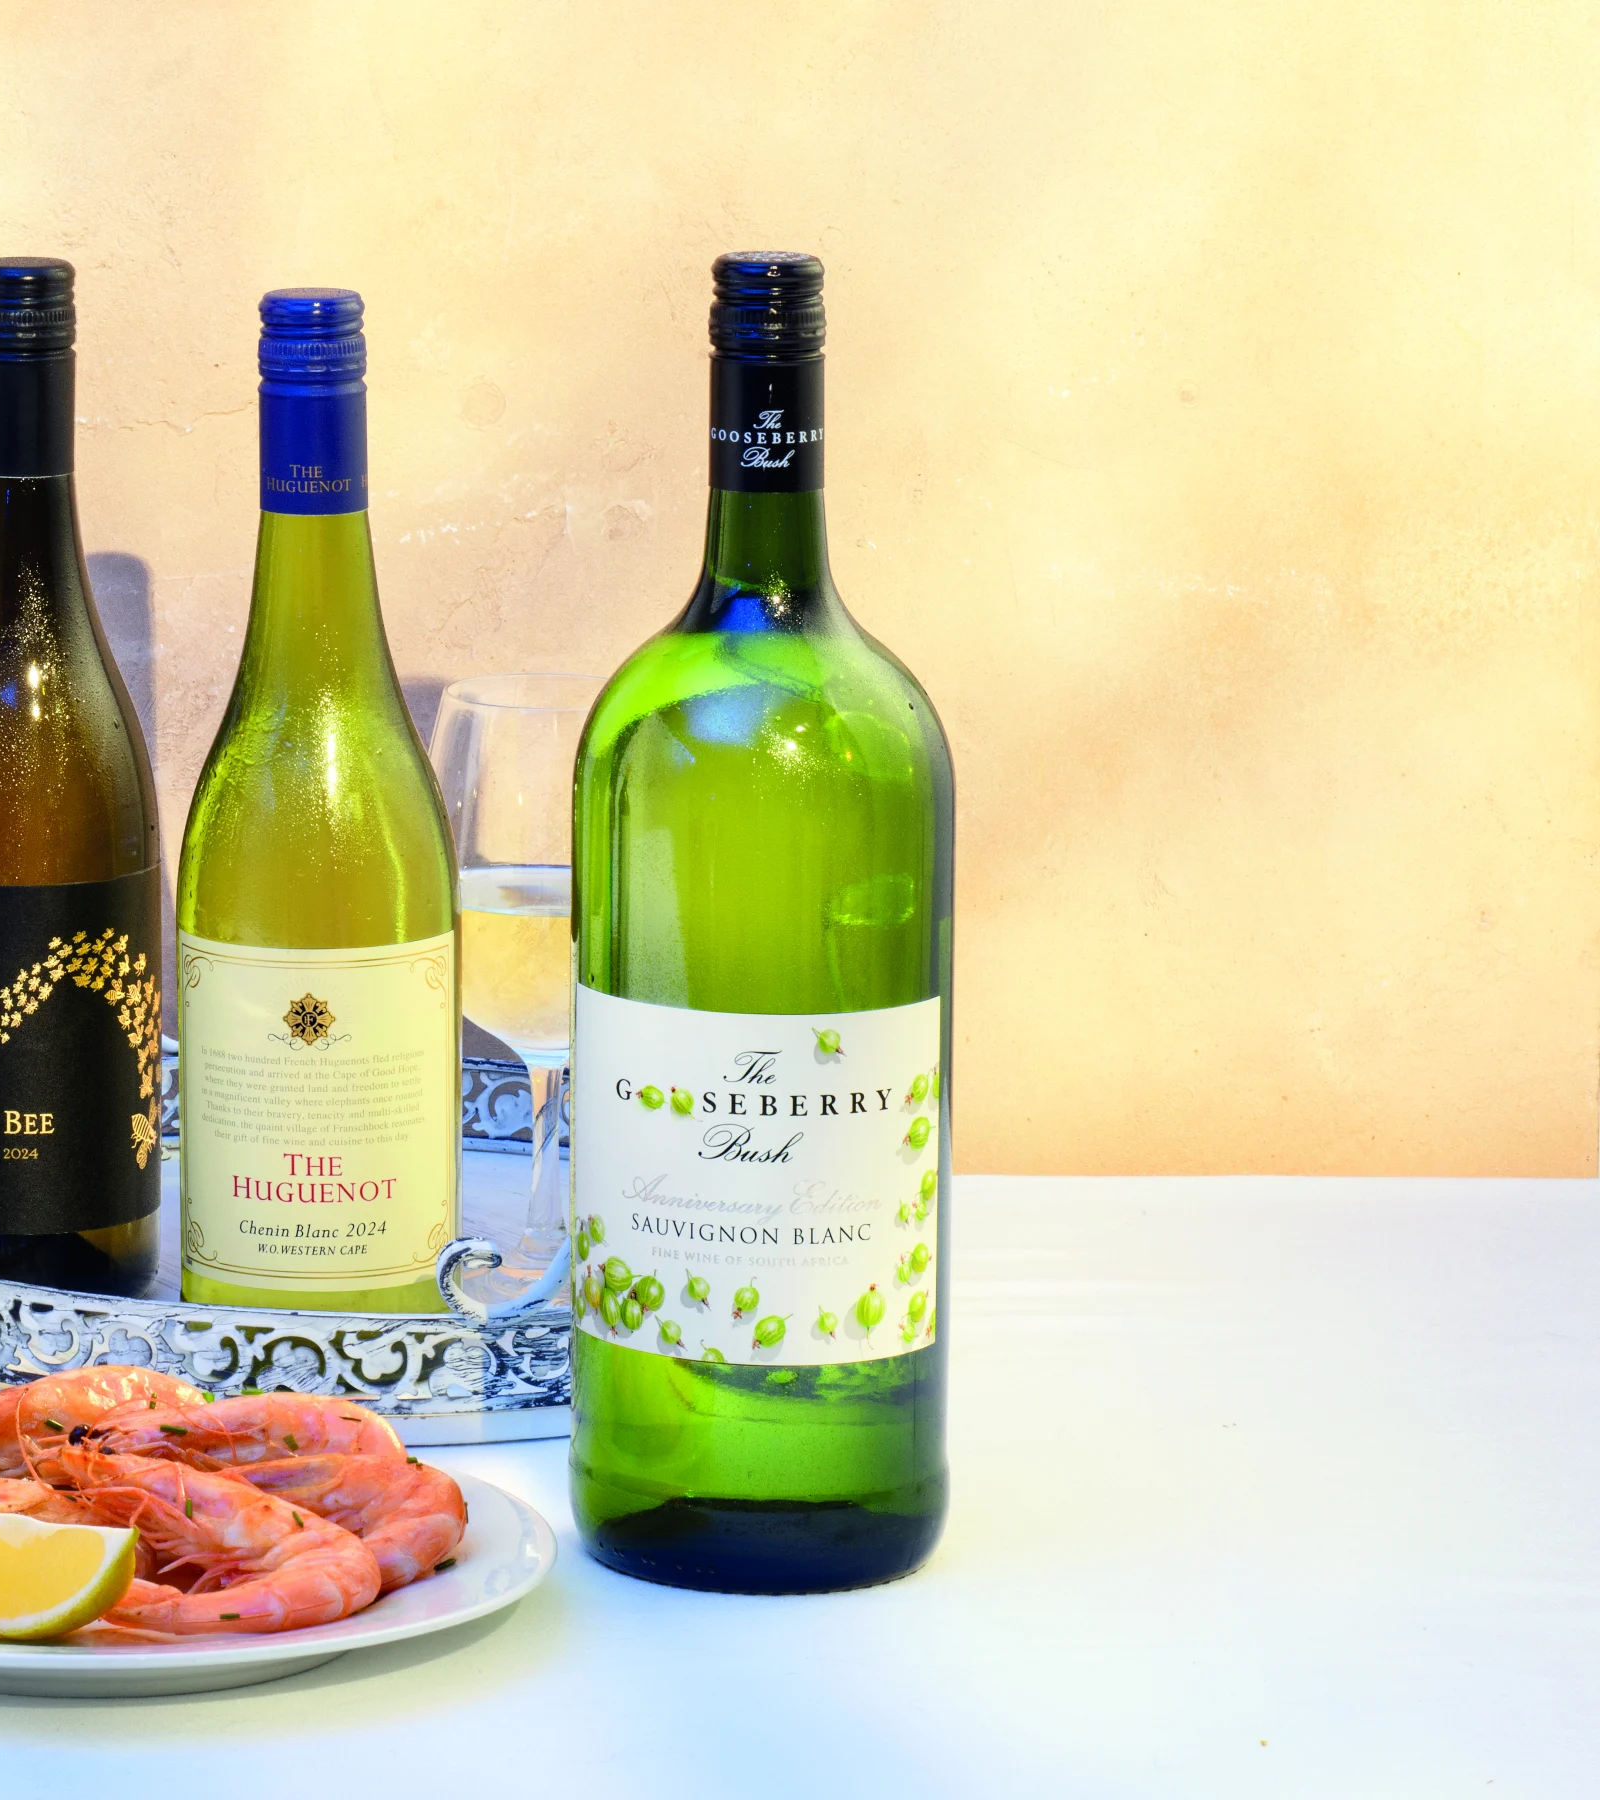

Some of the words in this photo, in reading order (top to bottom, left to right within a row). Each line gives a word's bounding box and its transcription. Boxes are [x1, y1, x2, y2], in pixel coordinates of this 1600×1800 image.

[753, 410, 784, 430] The
[711, 427, 824, 444] GOOSEBERRY
[740, 446, 796, 468] Bush
[289, 464, 322, 478] THE
[267, 476, 352, 493] HUGUENOT
[228, 1053, 242, 1061] two
[246, 1054, 280, 1065] hundred
[284, 1057, 316, 1066] French
[320, 1057, 370, 1068] Huguenots
[372, 1054, 389, 1064] fled
[392, 1050, 425, 1061] religious
[723, 1050, 783, 1085] The
[205, 1062, 246, 1076] persecution
[249, 1069, 264, 1077] and
[268, 1071, 300, 1080] arrived
[316, 1072, 329, 1080] the
[333, 1070, 356, 1080] Cape
[360, 1069, 370, 1078] of
[372, 1067, 396, 1077] Good
[205, 1075, 224, 1085] where
[226, 1078, 242, 1090] they
[270, 1084, 304, 1094] granted
[332, 1084, 348, 1092] and
[352, 1082, 388, 1092] freedom
[392, 1080, 399, 1088] to
[402, 1076, 422, 1086] settle
[215, 1091, 260, 1103] magnificent
[264, 1096, 291, 1107] valley
[294, 1098, 322, 1106] where
[326, 1097, 370, 1108] elephants
[373, 1095, 393, 1103] once
[206, 1100, 231, 1112] Thanks
[233, 1106, 241, 1114] to
[244, 1107, 264, 1117] their
[308, 1111, 345, 1121] tenacity
[349, 1110, 364, 1118] and
[3, 1110, 55, 1136] BEE
[241, 1120, 253, 1129] the
[256, 1123, 283, 1132] quaint
[287, 1124, 317, 1134] village
[320, 1124, 330, 1133] of
[334, 1121, 389, 1132] Franschhoek
[392, 1116, 425, 1128] resonates
[215, 1129, 231, 1139] their
[234, 1133, 248, 1143] gift
[250, 1135, 260, 1143] of
[262, 1136, 280, 1145] fine
[284, 1137, 305, 1146] wine
[309, 1137, 325, 1146] and
[329, 1136, 362, 1146] cuisine
[366, 1136, 374, 1144] to
[377, 1134, 392, 1143] this
[698, 1123, 804, 1164] Bush
[3, 1147, 39, 1160] 2024
[283, 1152, 344, 1177] THE
[232, 1174, 397, 1204] HUGUENOT
[622, 1173, 784, 1226] Anniversary
[789, 1180, 883, 1216] Edition
[239, 1219, 290, 1238] Chenin
[294, 1224, 339, 1238] Blanc
[346, 1220, 387, 1238] 2024
[631, 1212, 779, 1246] SAUVIGNON
[792, 1223, 872, 1246] BLANC
[340, 1244, 368, 1255] CAPE
[652, 1246, 680, 1260] FINE
[684, 1251, 720, 1265] WINE
[725, 1255, 743, 1266] OF
[748, 1256, 797, 1268] SOUTH
[801, 1256, 849, 1266] AFRICA
